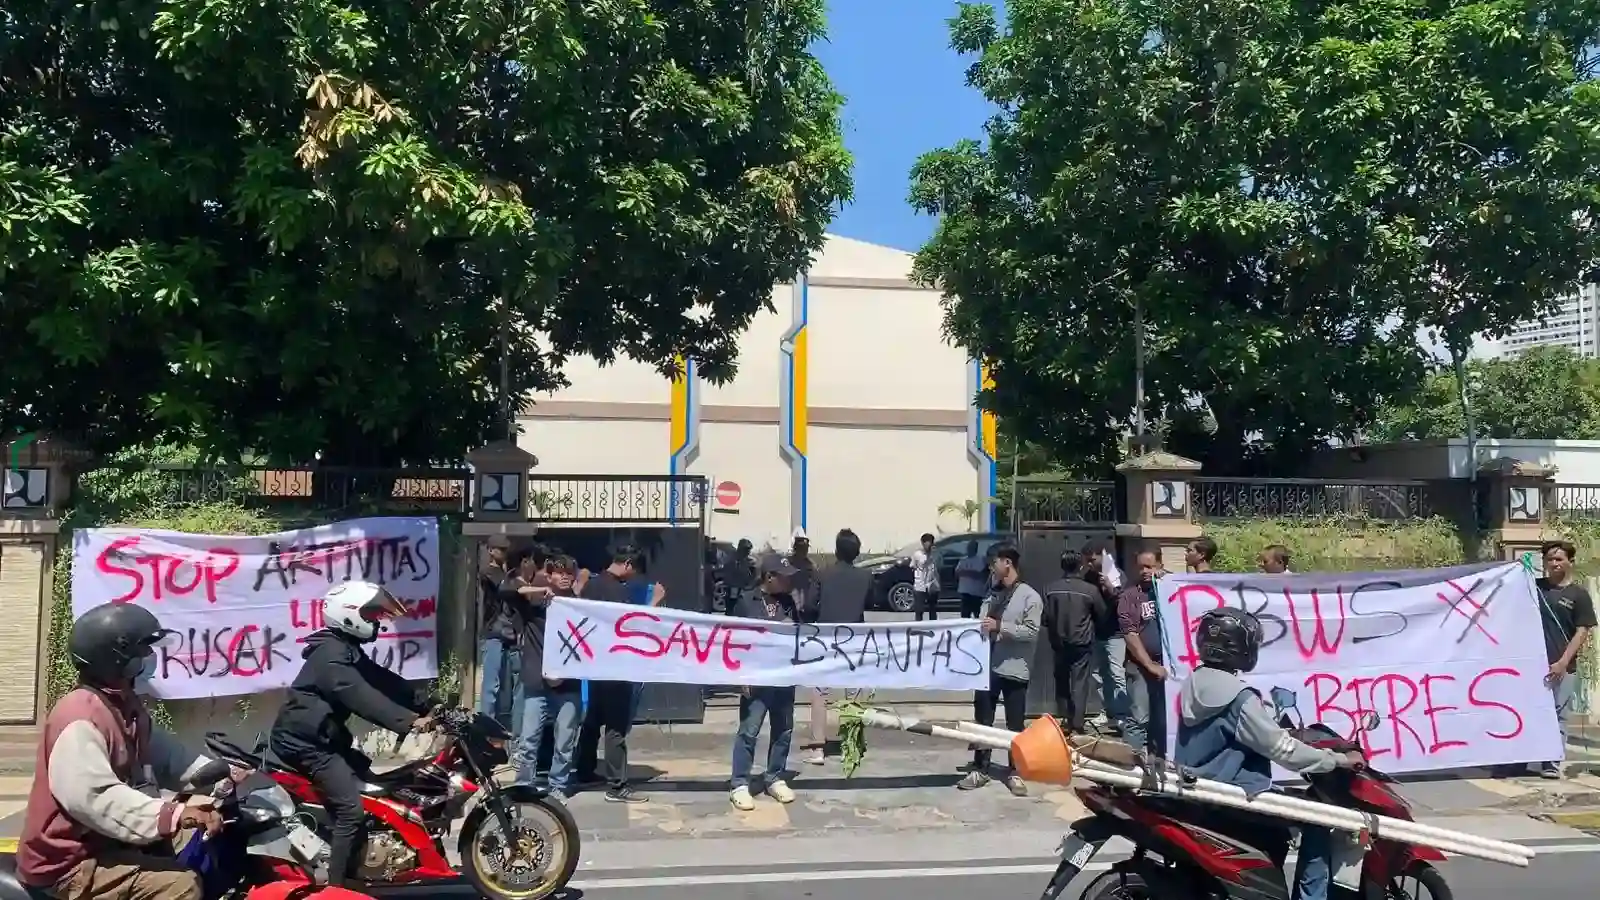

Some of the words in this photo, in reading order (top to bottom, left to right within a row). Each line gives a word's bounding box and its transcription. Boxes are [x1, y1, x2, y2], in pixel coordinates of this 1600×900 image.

[96, 536, 241, 604] STOP
[253, 537, 430, 592] AKTIVITAS
[609, 611, 769, 671] SAVE
[790, 622, 986, 676] BRANTAS
[1304, 667, 1524, 761] BERES
